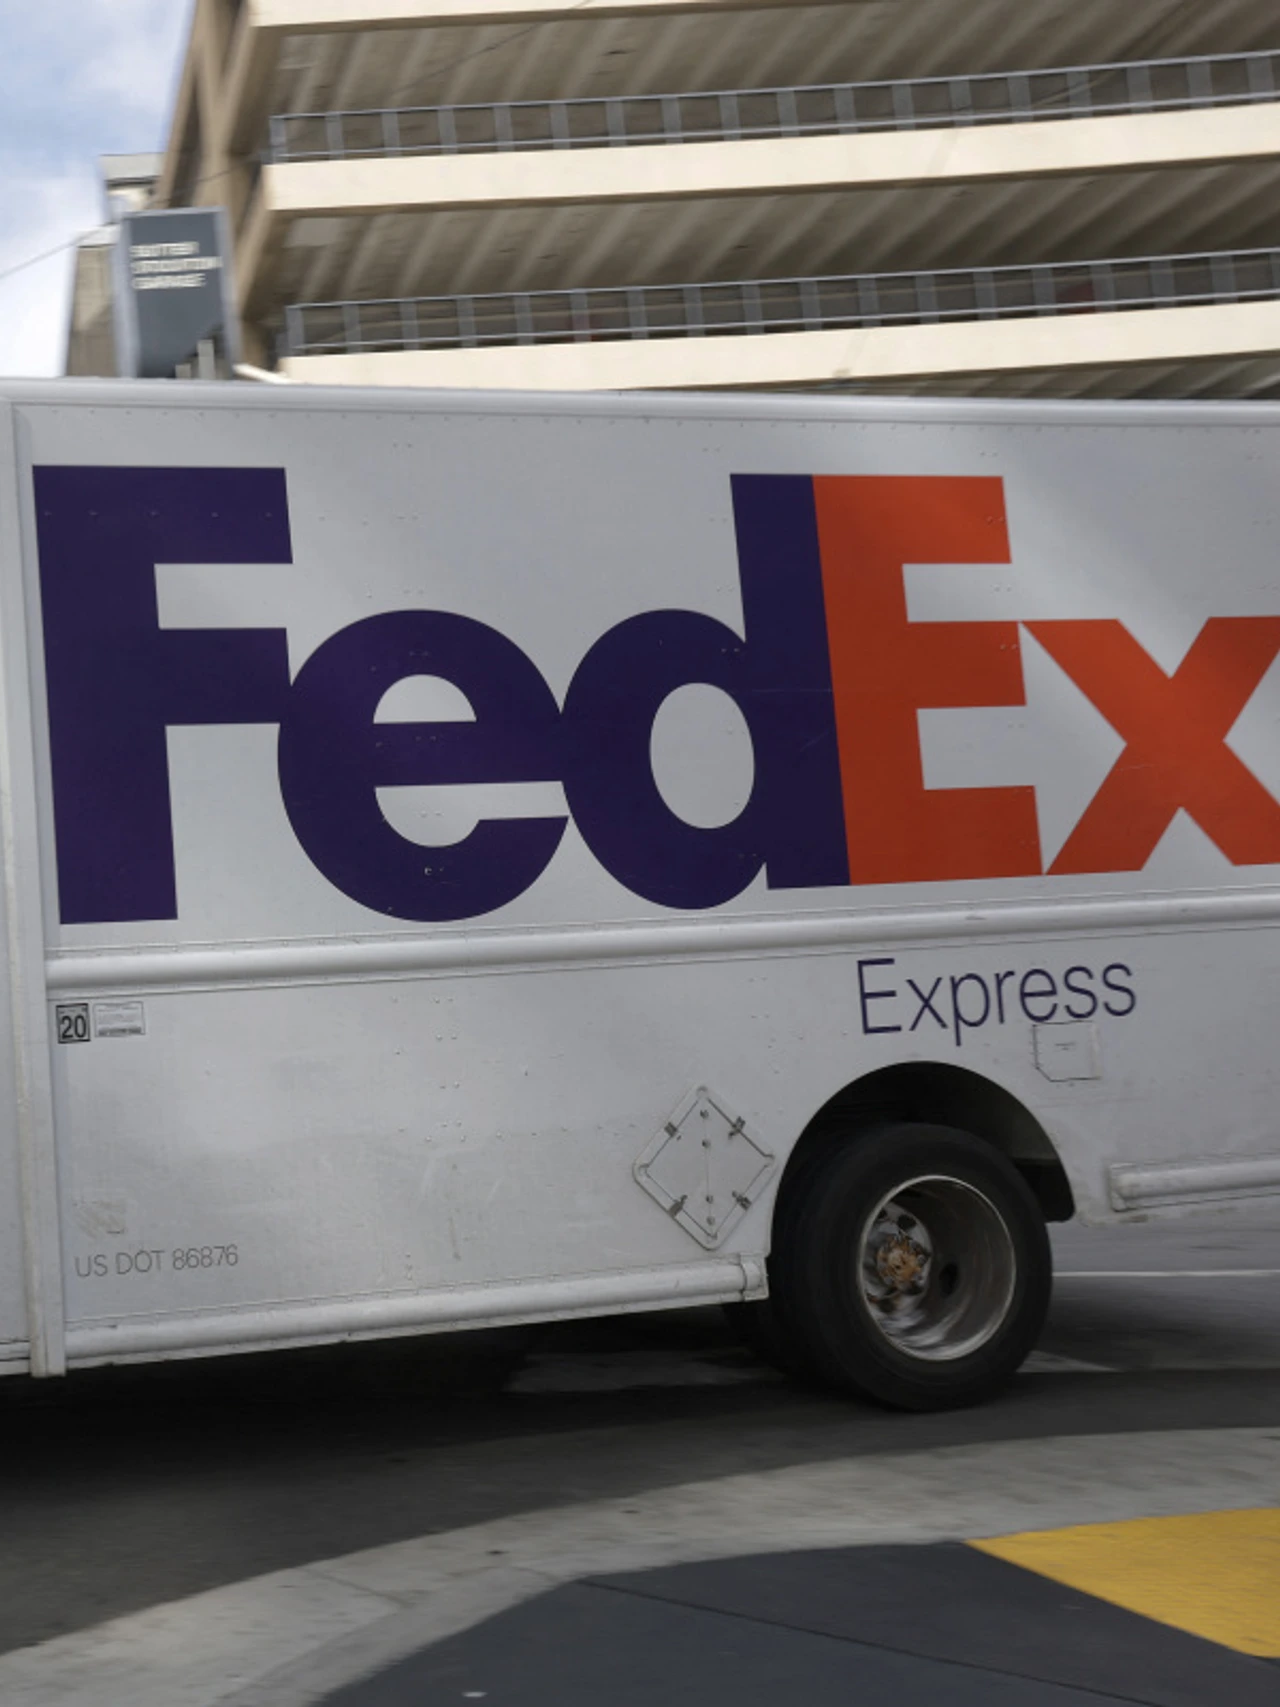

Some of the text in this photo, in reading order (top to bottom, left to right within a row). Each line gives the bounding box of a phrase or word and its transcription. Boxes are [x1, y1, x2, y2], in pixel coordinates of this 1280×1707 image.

[32, 464, 1280, 925] FedEx
[61, 1014, 87, 1040] 20
[857, 957, 1137, 1046] Express
[74, 1244, 239, 1278] US DOT 86876
